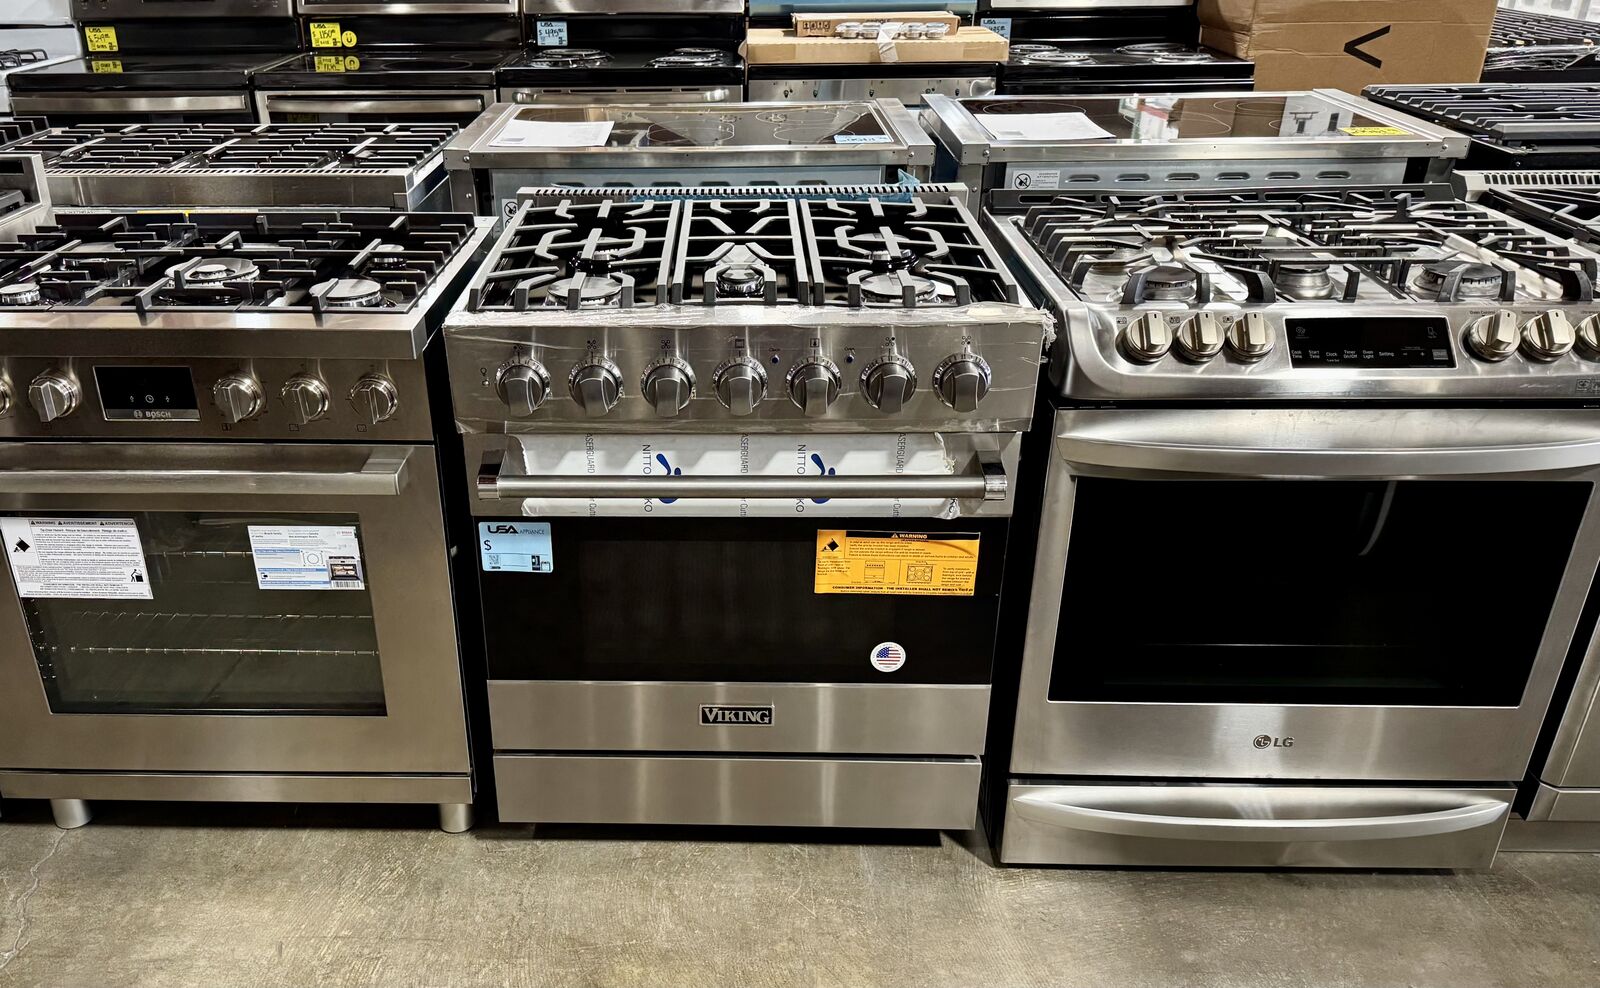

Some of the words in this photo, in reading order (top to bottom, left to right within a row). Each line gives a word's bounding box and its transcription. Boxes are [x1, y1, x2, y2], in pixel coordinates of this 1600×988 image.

[585, 433, 595, 474] ASERGUARD
[642, 444, 652, 474] NITTO
[741, 433, 749, 474] ASERGUARD
[797, 444, 806, 474] NITTO
[896, 433, 906, 474] ASERGUARD
[487, 525, 519, 534] USA
[484, 540, 492, 550] $
[703, 708, 770, 723] VIKING
[1274, 737, 1294, 747] LG
